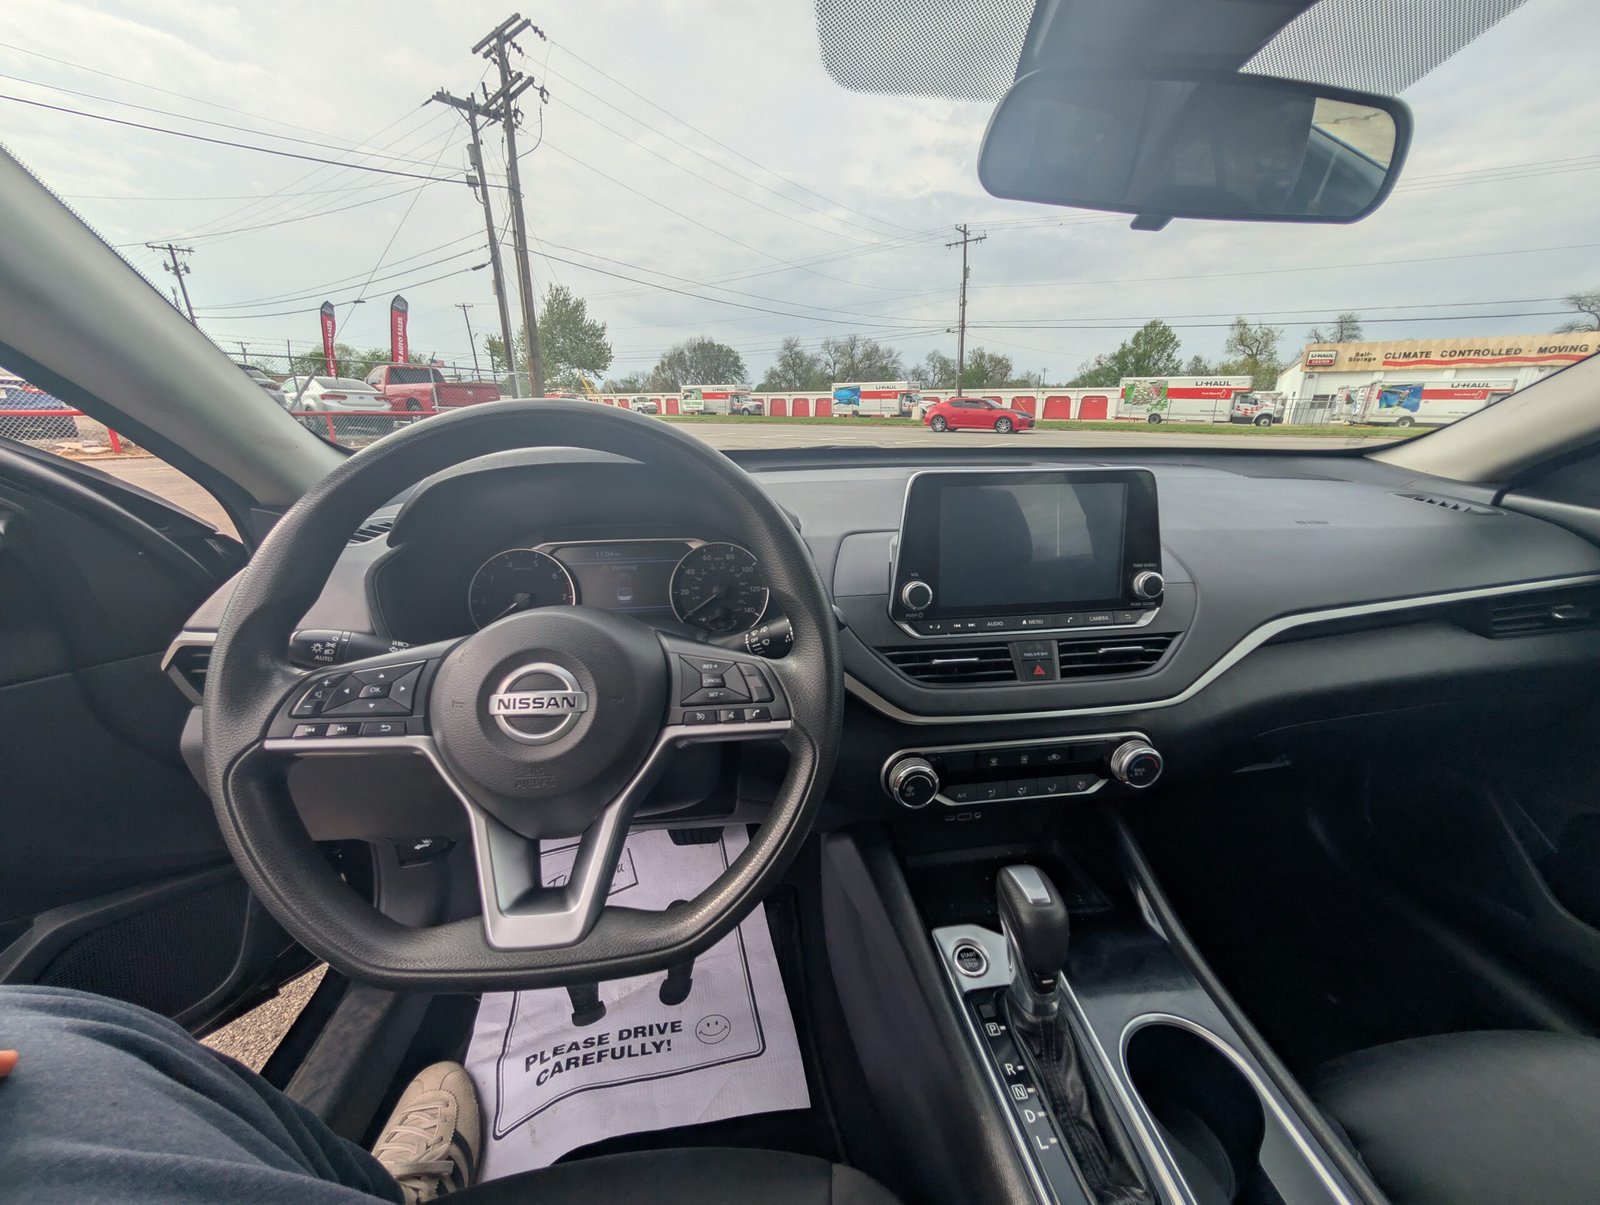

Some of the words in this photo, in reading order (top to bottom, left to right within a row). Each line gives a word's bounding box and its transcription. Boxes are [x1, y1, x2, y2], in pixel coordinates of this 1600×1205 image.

[1384, 350, 1432, 360] CLIMATE
[1440, 347, 1522, 358] CONTROLLED
[1537, 344, 1589, 354] MOVING
[497, 696, 577, 710] NISSAN
[525, 1032, 610, 1072] PLEASE
[618, 1020, 683, 1041] DRIVE
[536, 1039, 672, 1087] CAREFULLY!
[1005, 1063, 1016, 1075] R
[1024, 1110, 1036, 1123] D
[1036, 1135, 1049, 1150] L
